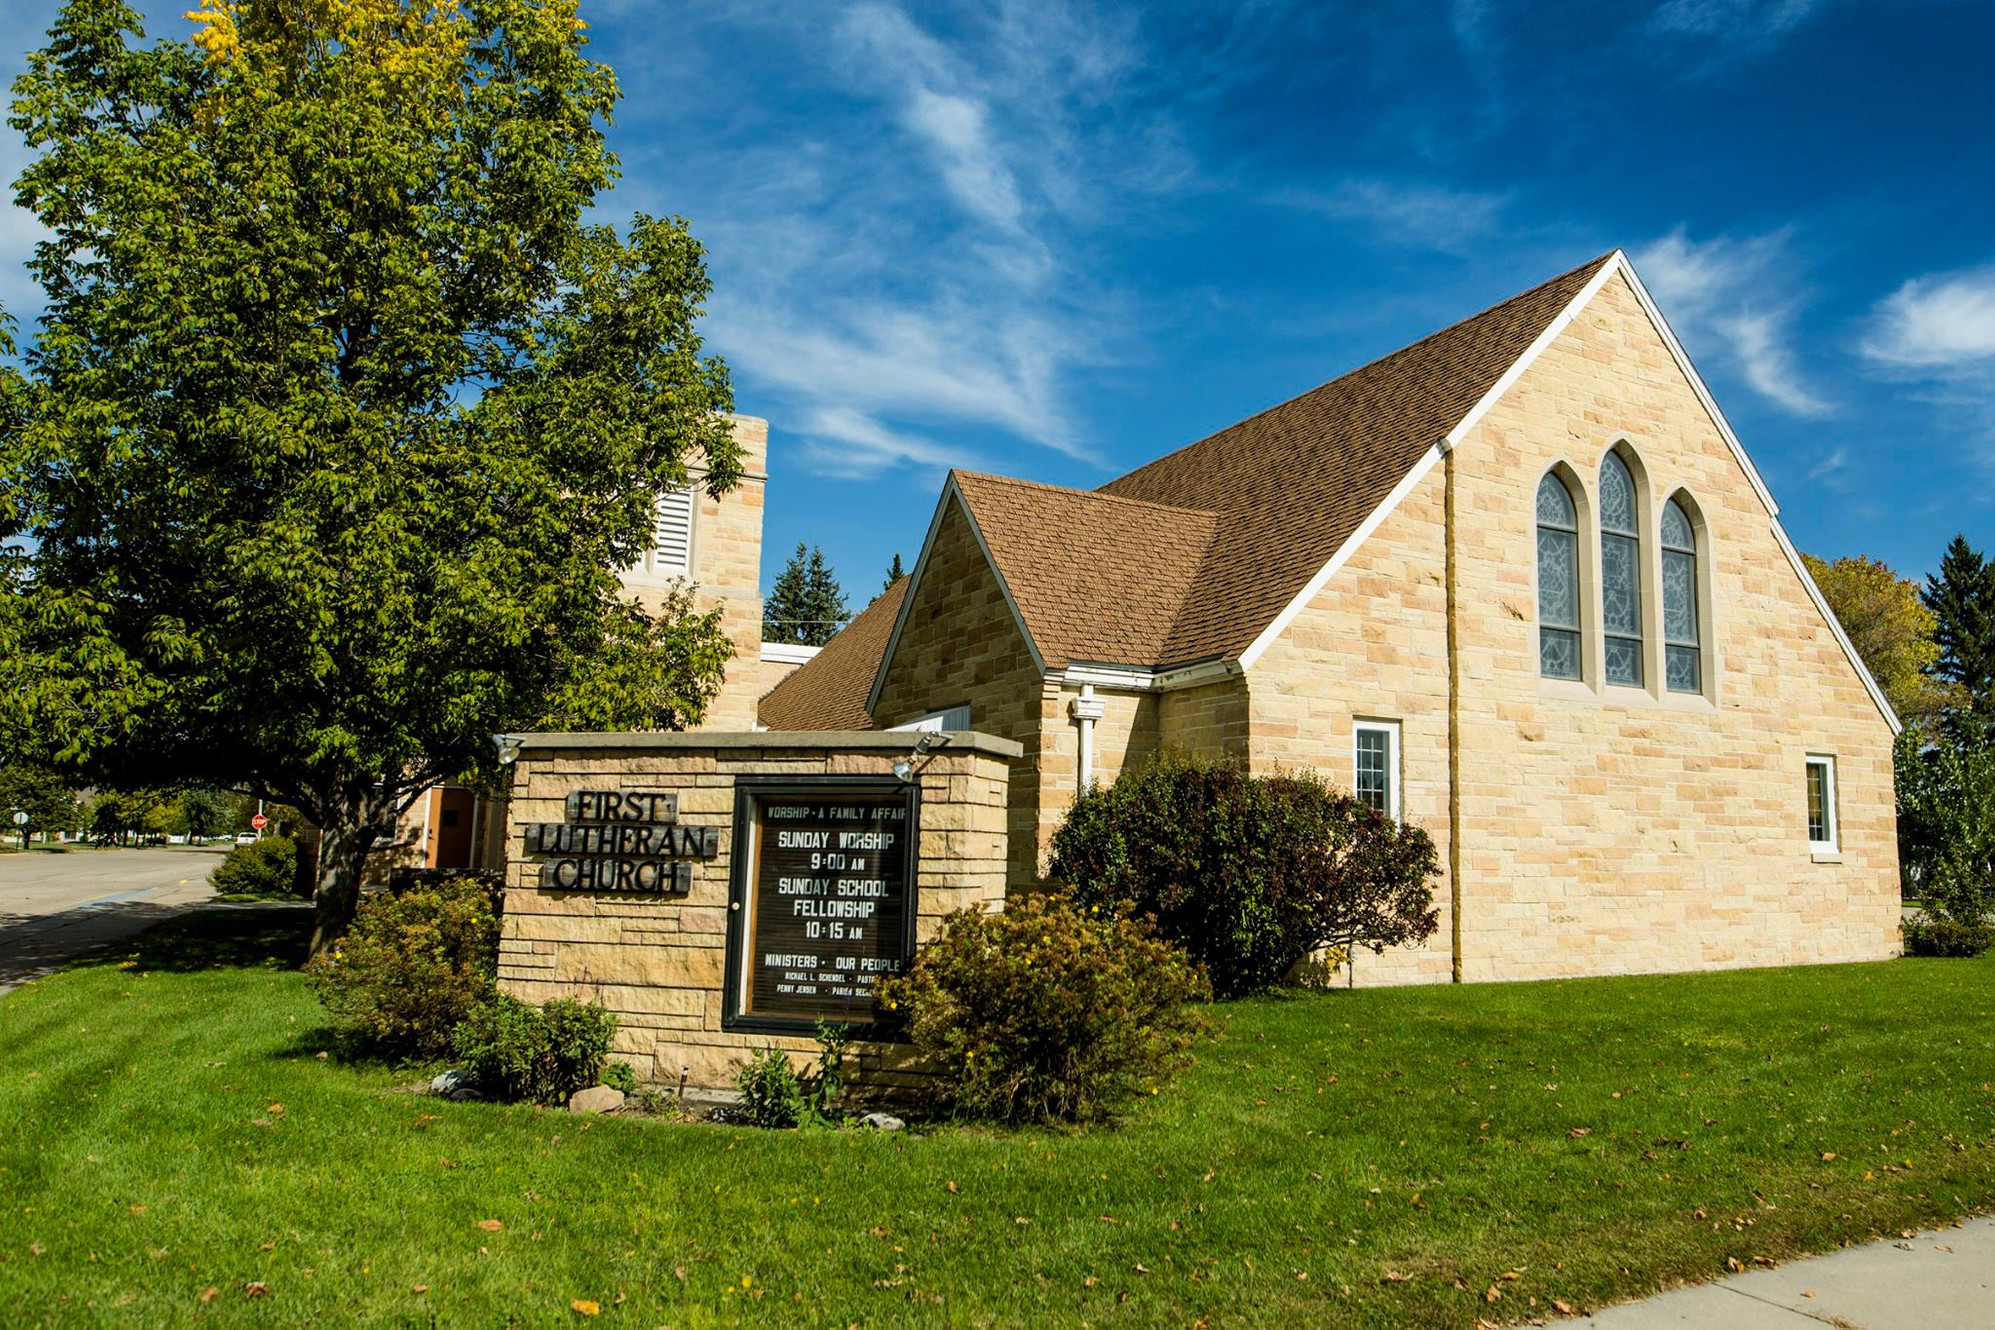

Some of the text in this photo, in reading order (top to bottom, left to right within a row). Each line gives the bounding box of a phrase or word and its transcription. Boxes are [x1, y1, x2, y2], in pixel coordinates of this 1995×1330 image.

[577, 791, 667, 822] FIRST
[768, 806, 809, 819] WORSHIP
[818, 807, 824, 819] A
[829, 807, 865, 820] FAMILY
[537, 824, 706, 857] LUTHERAN
[778, 831, 894, 850] SUNDAY WORSHIP
[811, 853, 865, 871] 9:00 AM
[553, 859, 678, 892] CHURCH
[778, 877, 889, 897] SUNDAY SCHOOL
[793, 899, 875, 918] FELLOWSHIP
[806, 921, 863, 940] 10:15 AM
[764, 953, 900, 972] MINISTERS OUR PEOPLE
[785, 971, 808, 981] MICHAEL
[777, 984, 794, 993] PENNY
